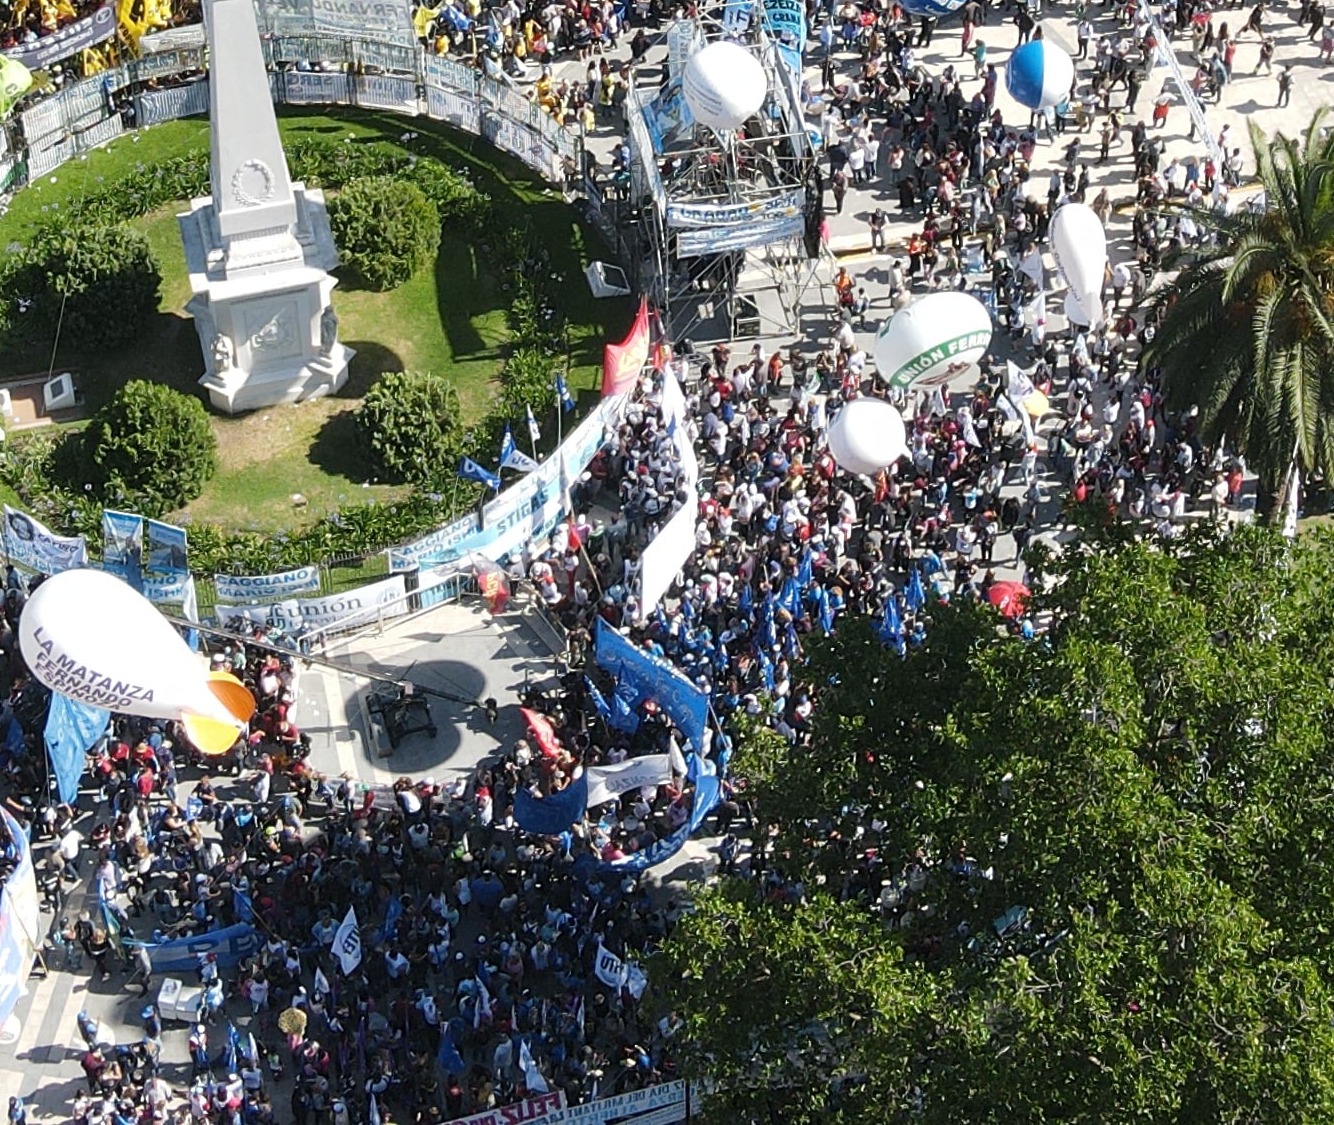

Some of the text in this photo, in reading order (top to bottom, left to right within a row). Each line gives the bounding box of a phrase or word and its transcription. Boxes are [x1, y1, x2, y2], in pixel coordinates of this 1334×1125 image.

[897, 346, 946, 385] UNIÓN
[216, 570, 309, 586] CAGGIANO
[285, 596, 363, 617] unión
[32, 626, 156, 703] LA MATANZA
[34, 661, 122, 712] ESPINOZA
[36, 650, 133, 708] FERNANDO
